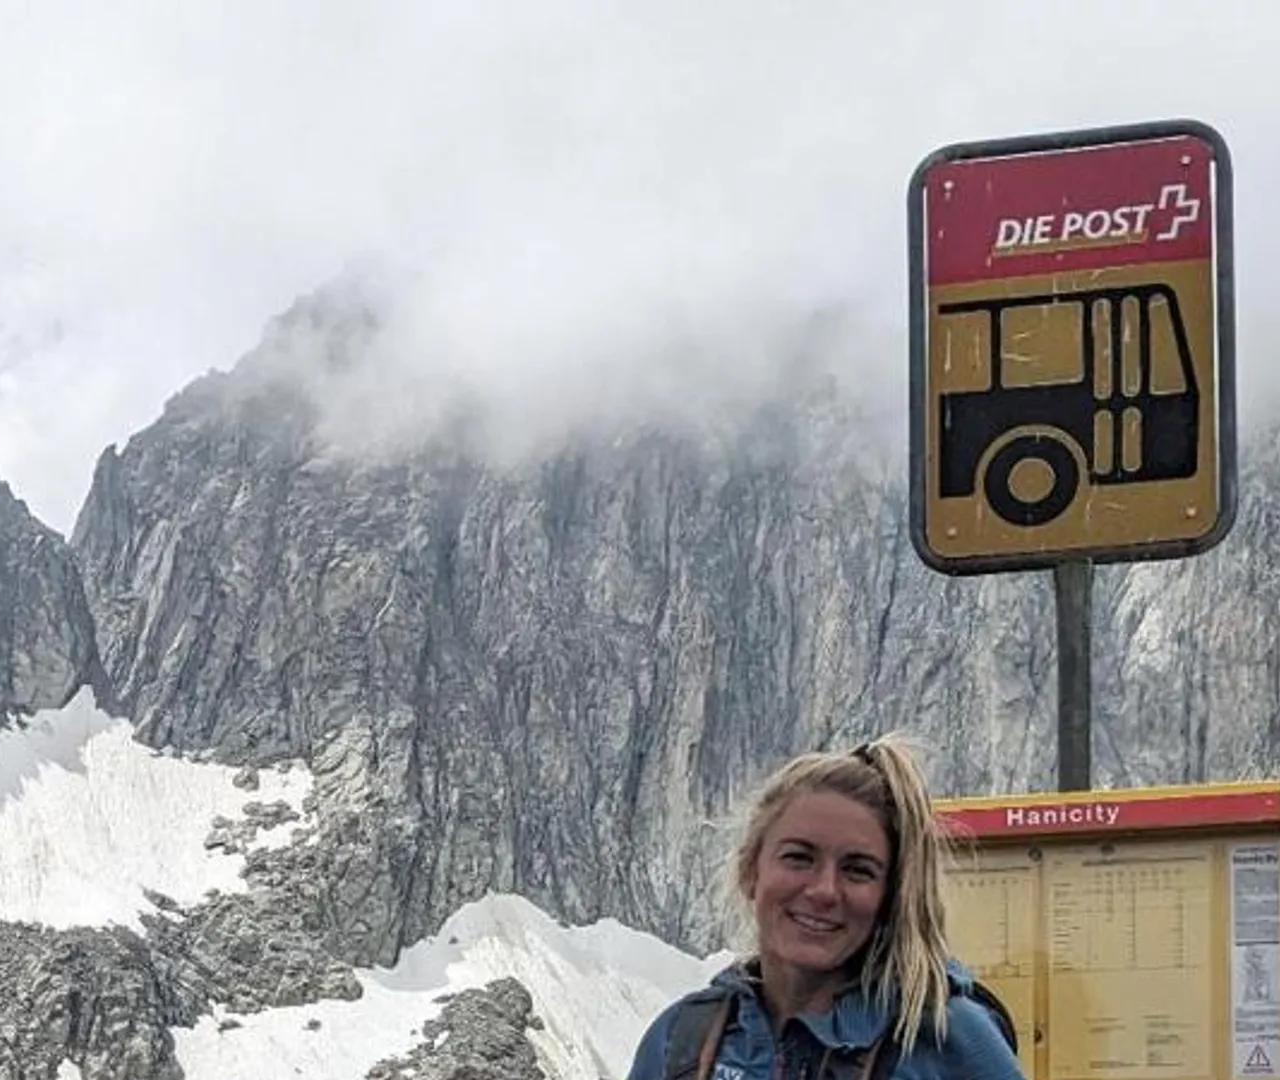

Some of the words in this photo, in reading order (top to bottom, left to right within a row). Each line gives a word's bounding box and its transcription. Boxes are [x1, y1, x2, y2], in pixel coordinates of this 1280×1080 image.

[994, 215, 1054, 248] DIE
[1061, 204, 1156, 241] POST
[1006, 804, 1120, 827] Hanicity
